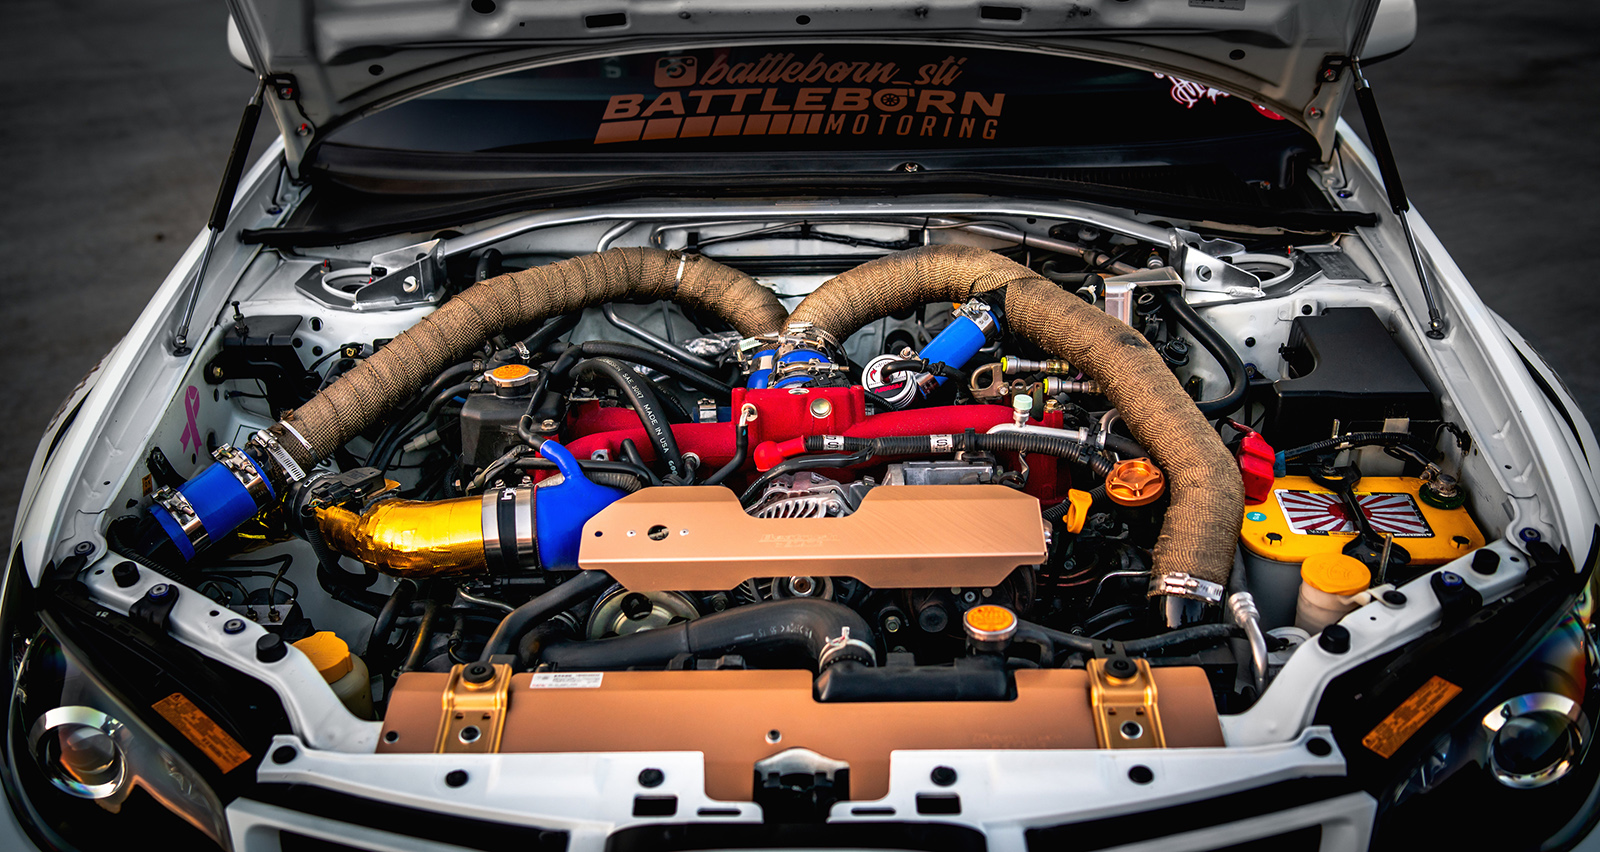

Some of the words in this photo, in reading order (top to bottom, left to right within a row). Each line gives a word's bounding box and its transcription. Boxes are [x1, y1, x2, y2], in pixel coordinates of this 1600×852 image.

[699, 52, 968, 86] battleborn_sti
[602, 87, 1006, 120] BATTLEBORN
[823, 113, 999, 140] MOTORING
[622, 372, 635, 385] SAE
[643, 403, 659, 426] MADE
[654, 426, 663, 436] IN
[659, 437, 670, 454] USA
